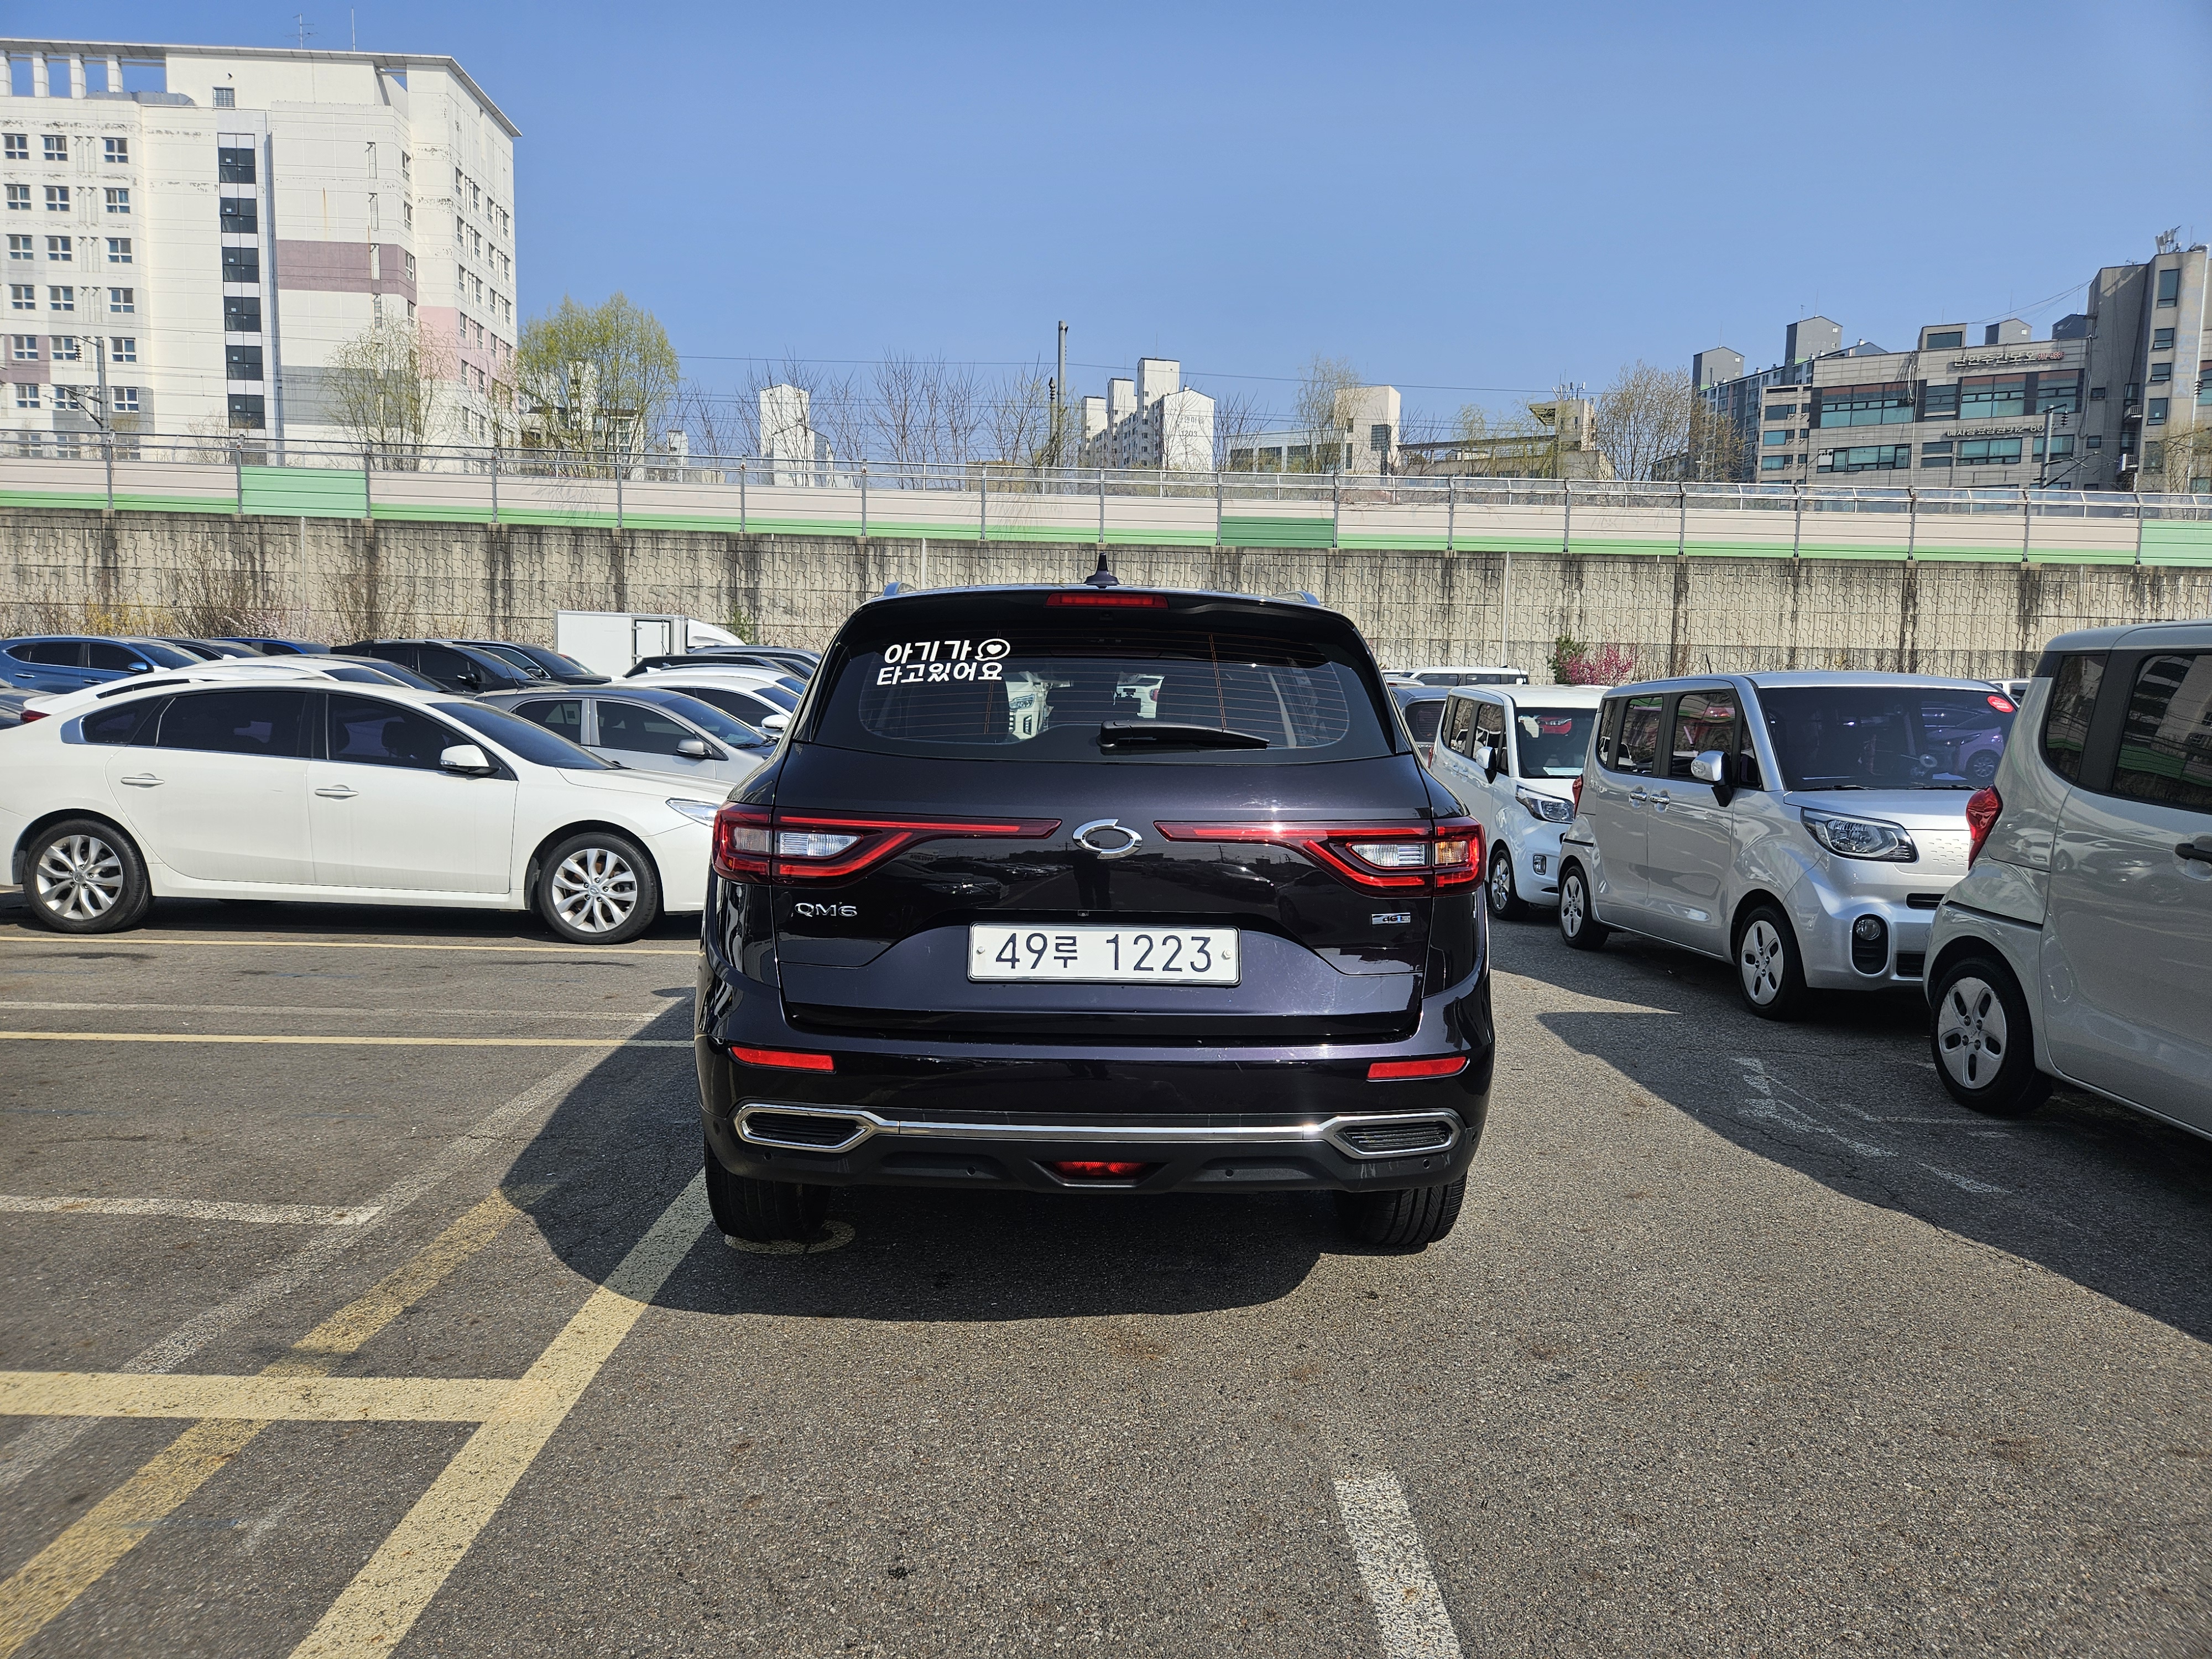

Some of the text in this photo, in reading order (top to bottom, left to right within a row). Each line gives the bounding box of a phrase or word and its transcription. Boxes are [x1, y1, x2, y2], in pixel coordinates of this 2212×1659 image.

[884, 640, 972, 664] 아기가
[876, 662, 1003, 686] 타고있어요
[795, 902, 858, 917] QM6
[996, 932, 1212, 973] 49루 1223
